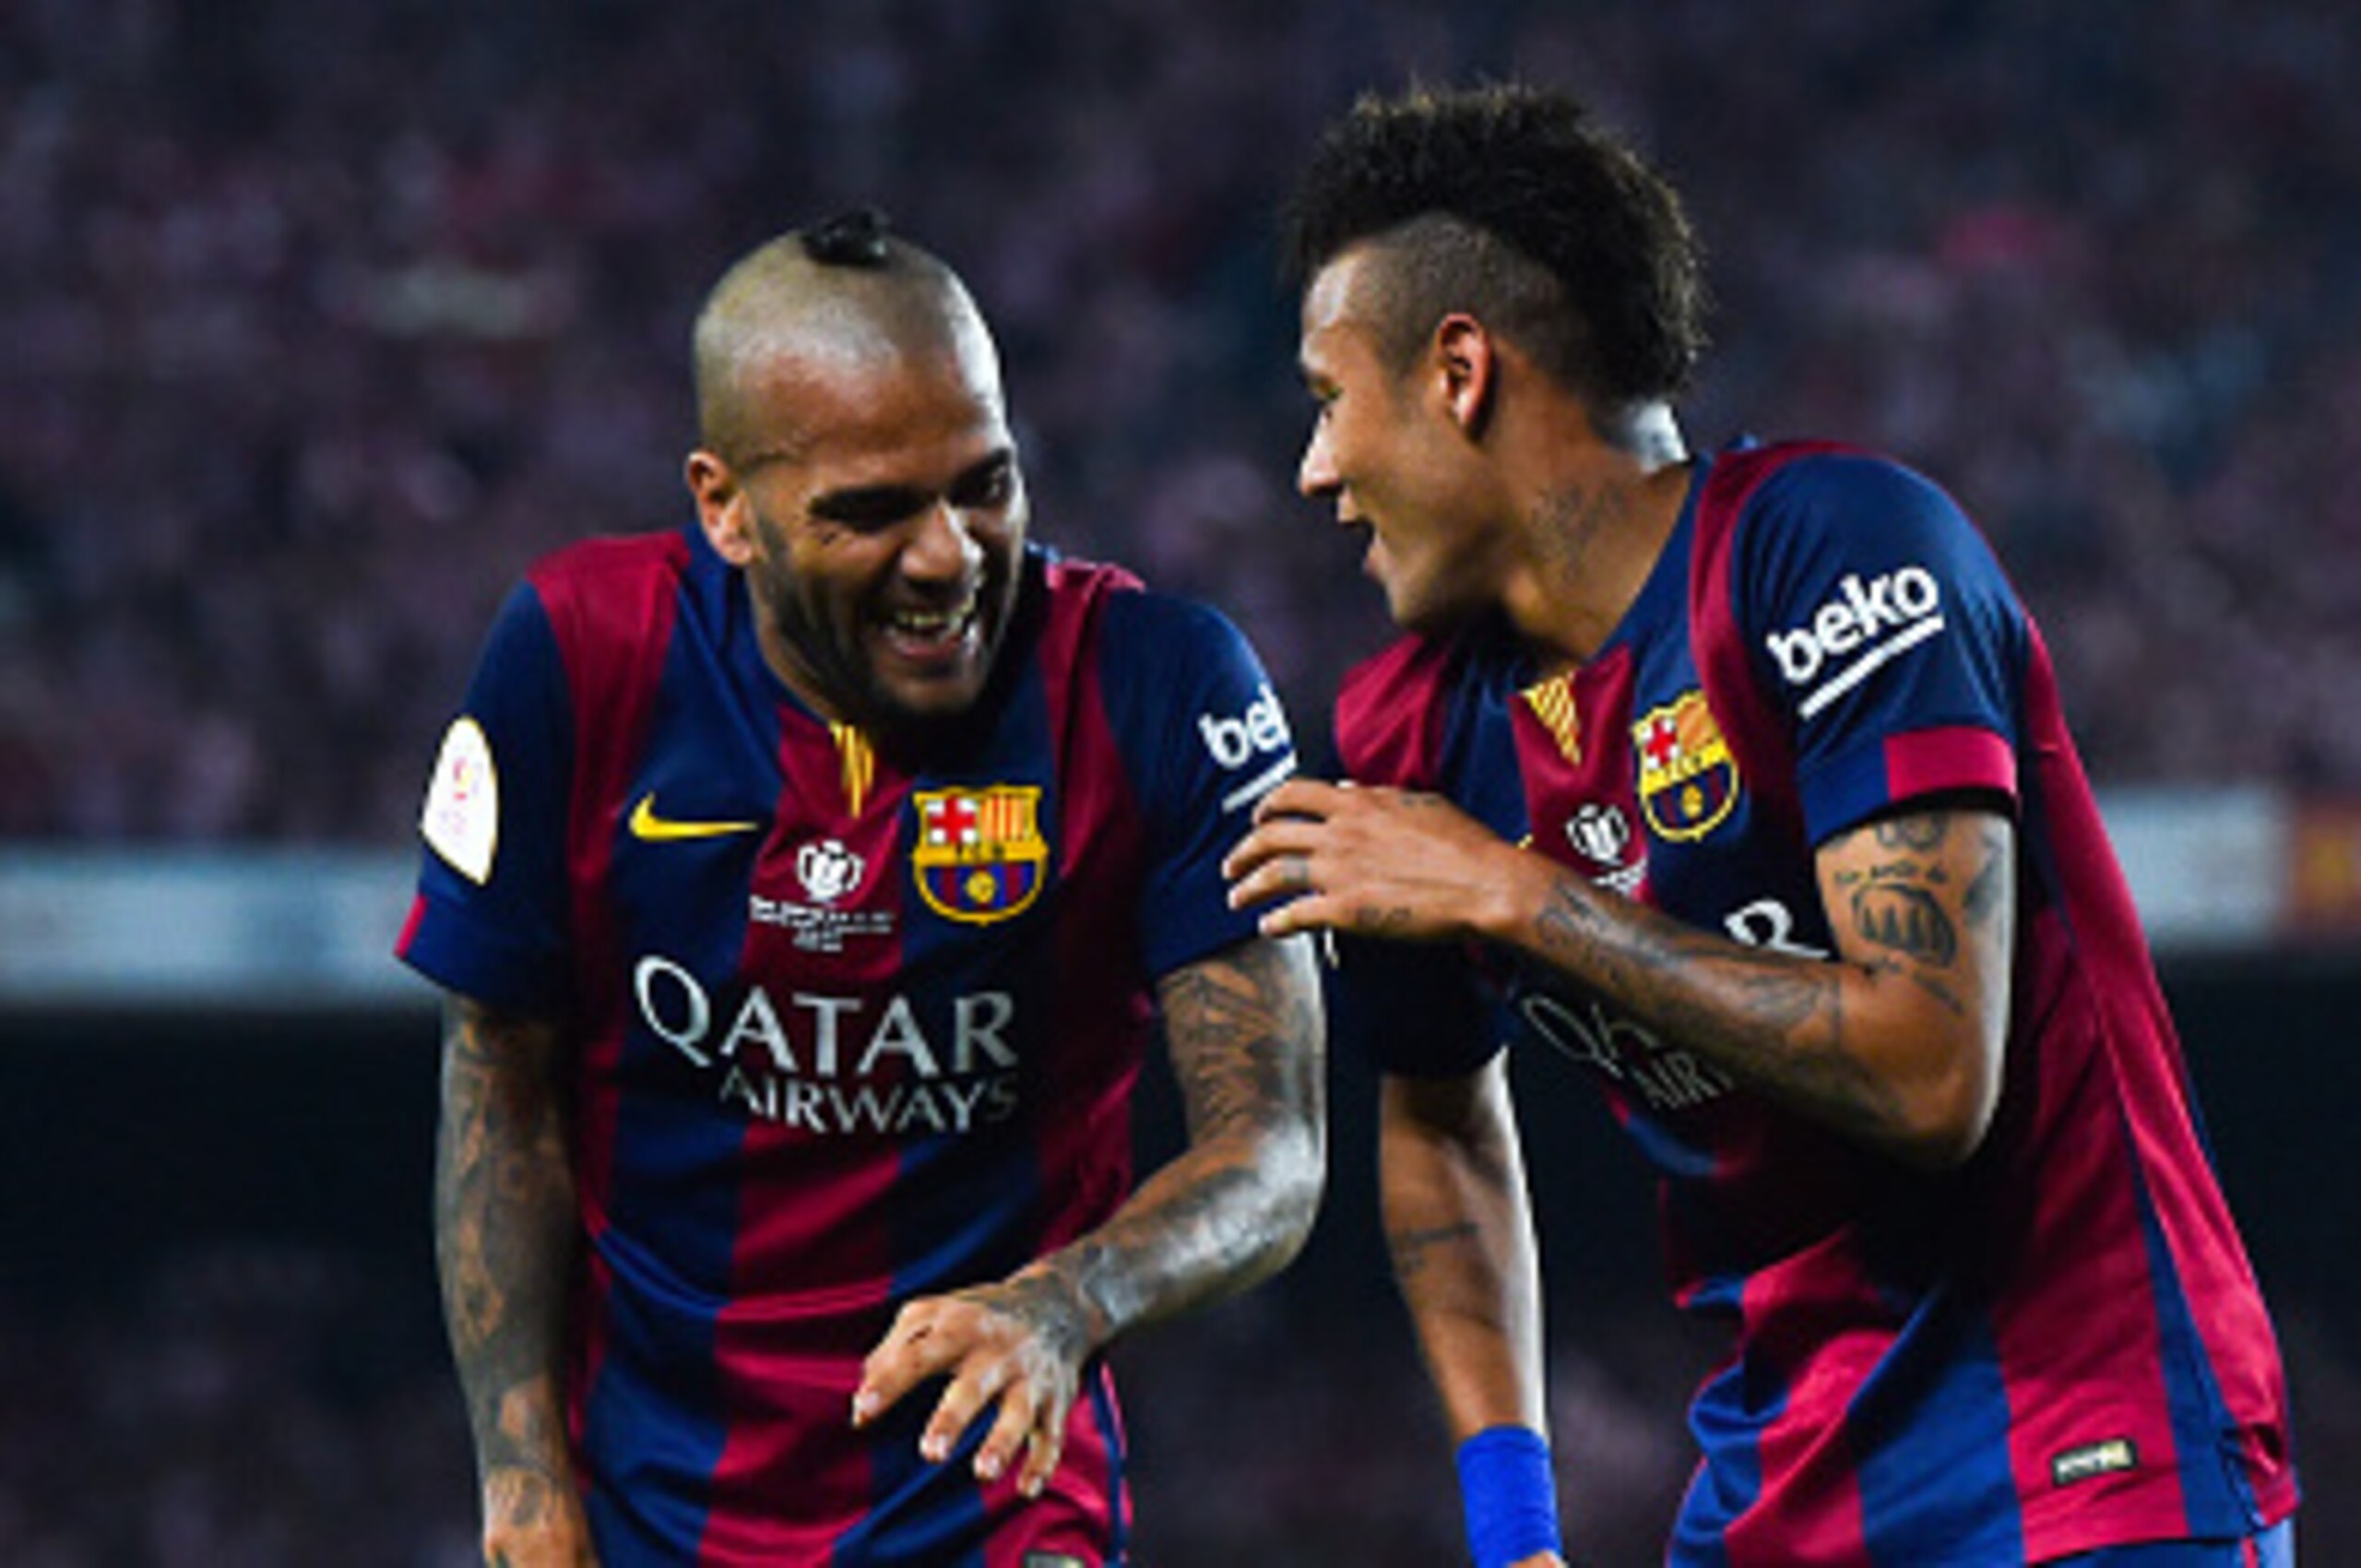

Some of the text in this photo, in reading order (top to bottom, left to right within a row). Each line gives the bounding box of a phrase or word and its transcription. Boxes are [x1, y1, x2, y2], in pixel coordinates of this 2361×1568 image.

[1765, 566, 1940, 684] beko
[635, 954, 1016, 1076] QATAR
[719, 1064, 1019, 1133] AIRWAYS
